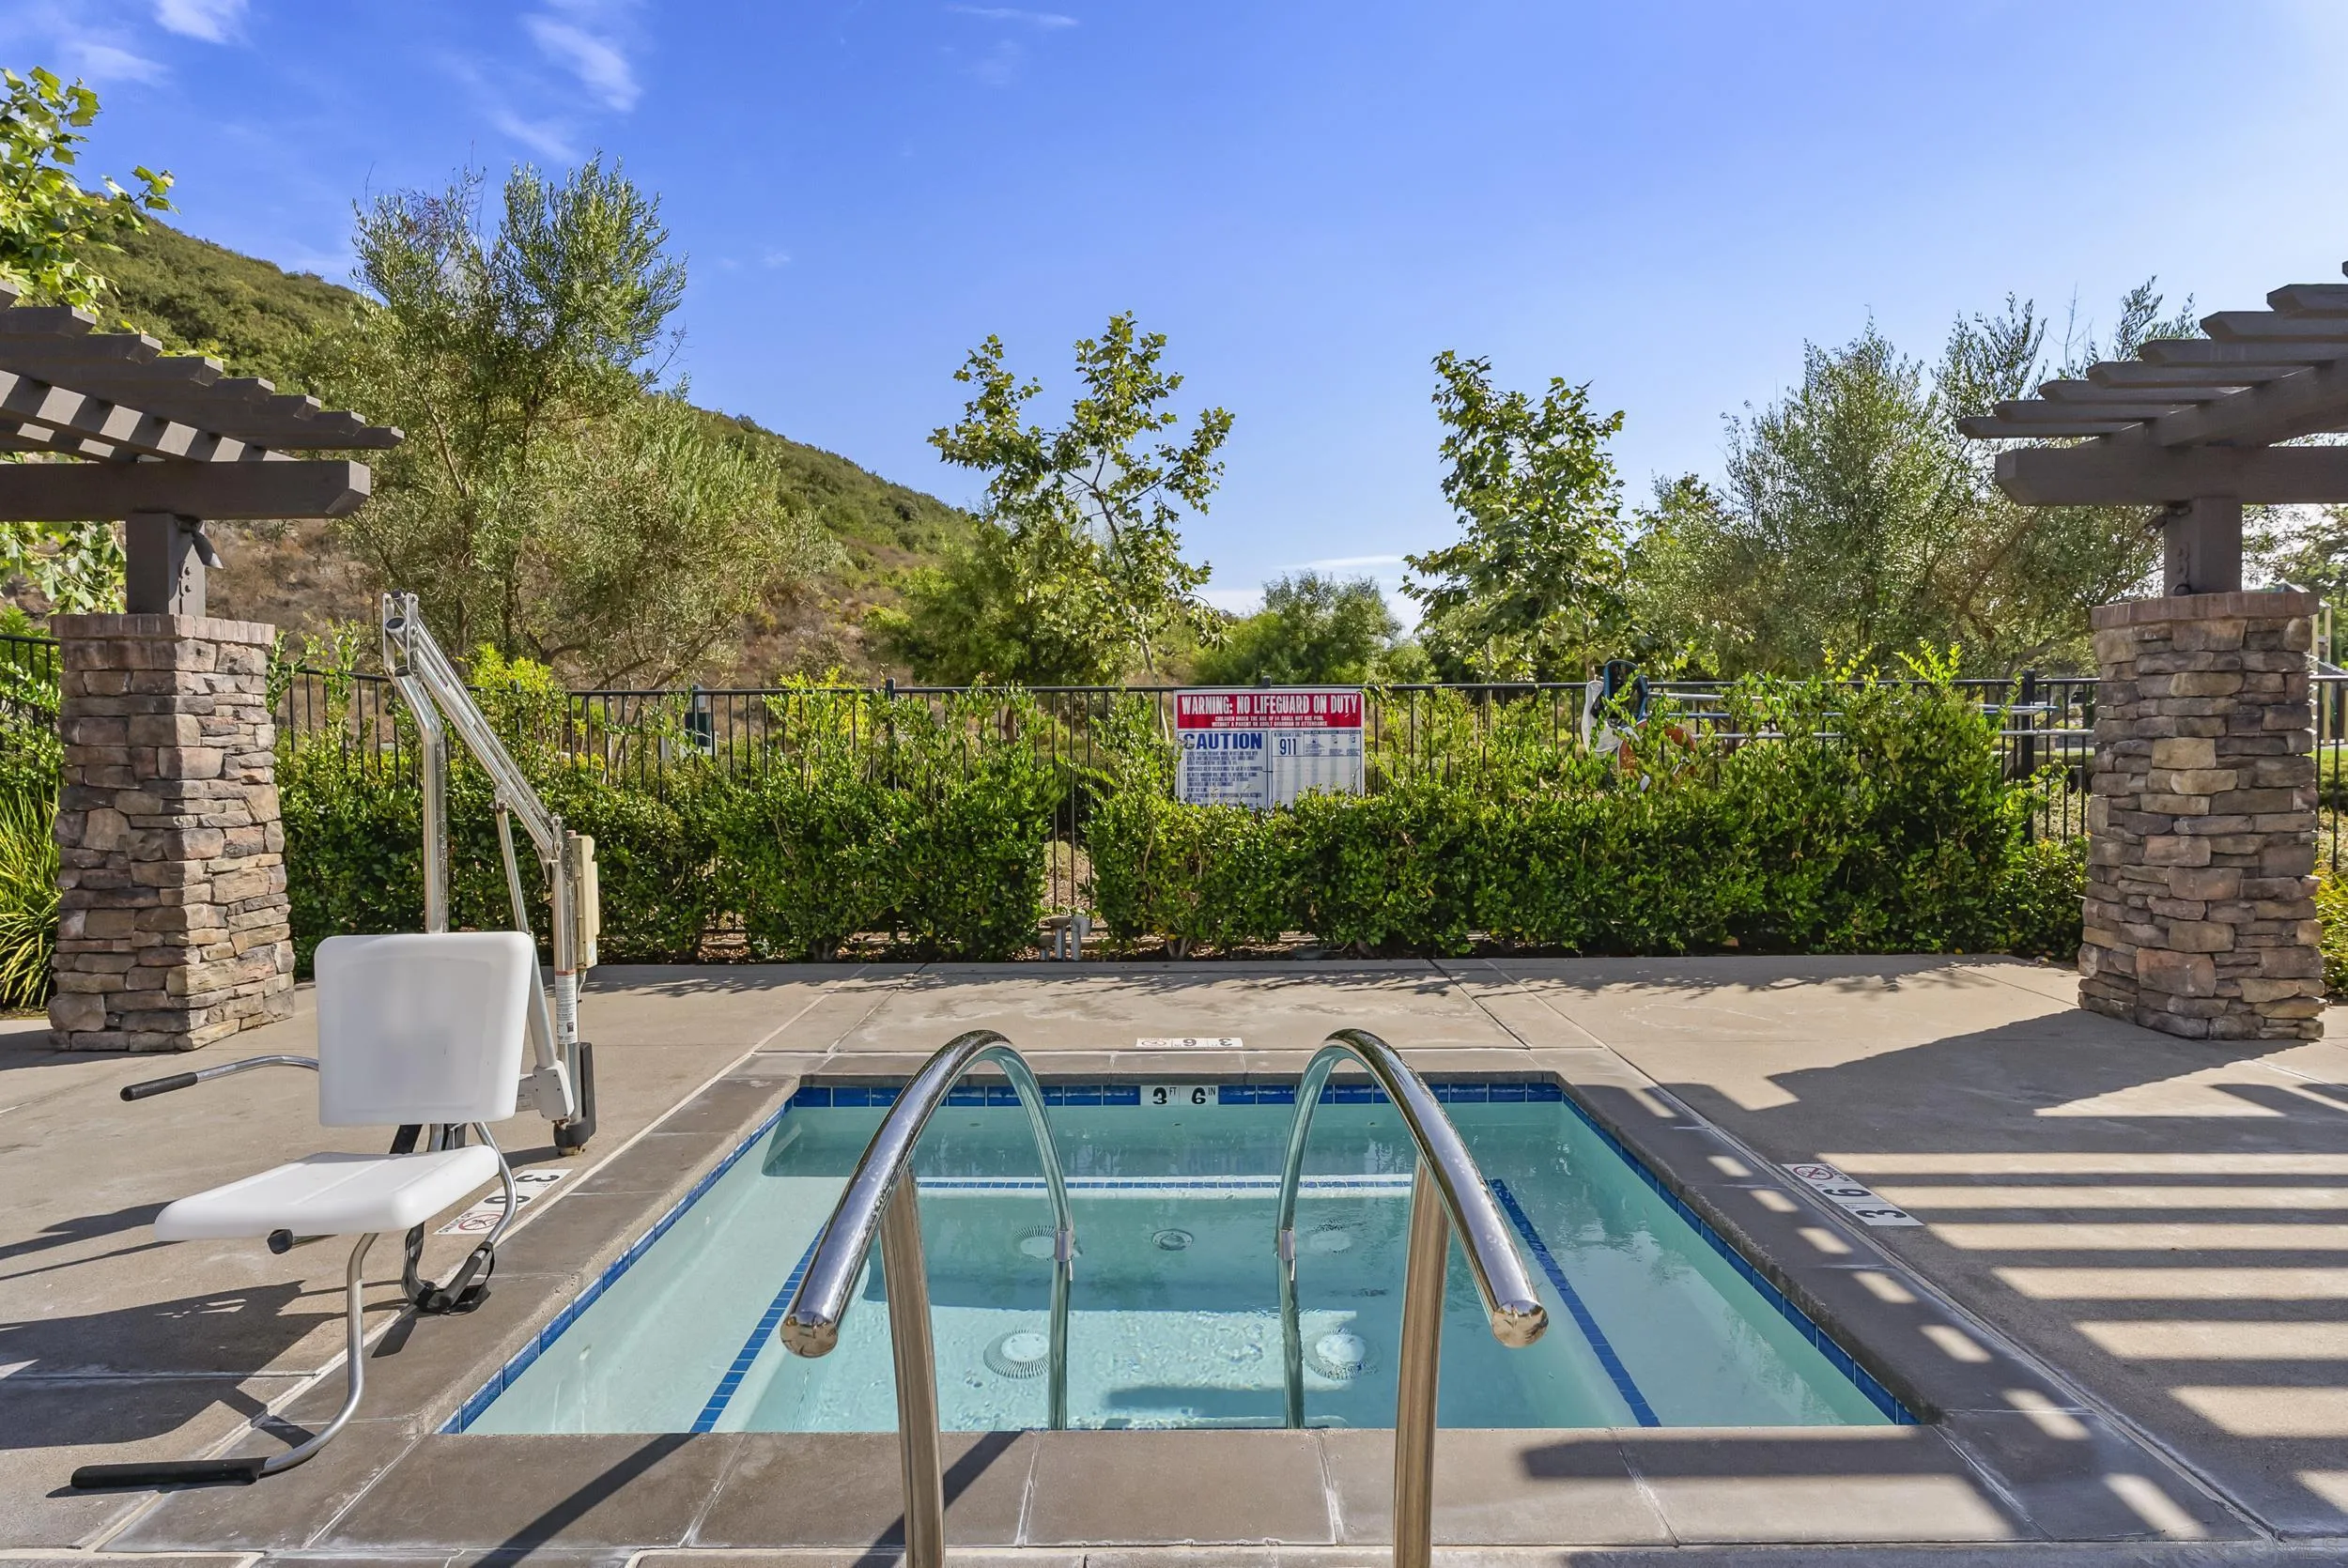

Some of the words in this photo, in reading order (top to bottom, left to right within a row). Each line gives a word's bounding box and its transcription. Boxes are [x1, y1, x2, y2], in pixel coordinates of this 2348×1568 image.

[1182, 696, 1233, 715] WARNING:
[1237, 696, 1250, 715] NO
[1254, 695, 1309, 715] LIFEGUARD
[1313, 695, 1327, 714] ON
[1331, 695, 1358, 714] DUTY
[1183, 733, 1262, 749] CAUTION
[1279, 738, 1296, 755] 911
[1218, 1038, 1233, 1046] 3
[1152, 1087, 1167, 1104] 3
[1169, 1087, 1177, 1096] FT
[1191, 1087, 1206, 1104] 6
[1208, 1087, 1216, 1096] IN
[1823, 1189, 1871, 1197] 6
[1855, 1209, 1907, 1219] 3
